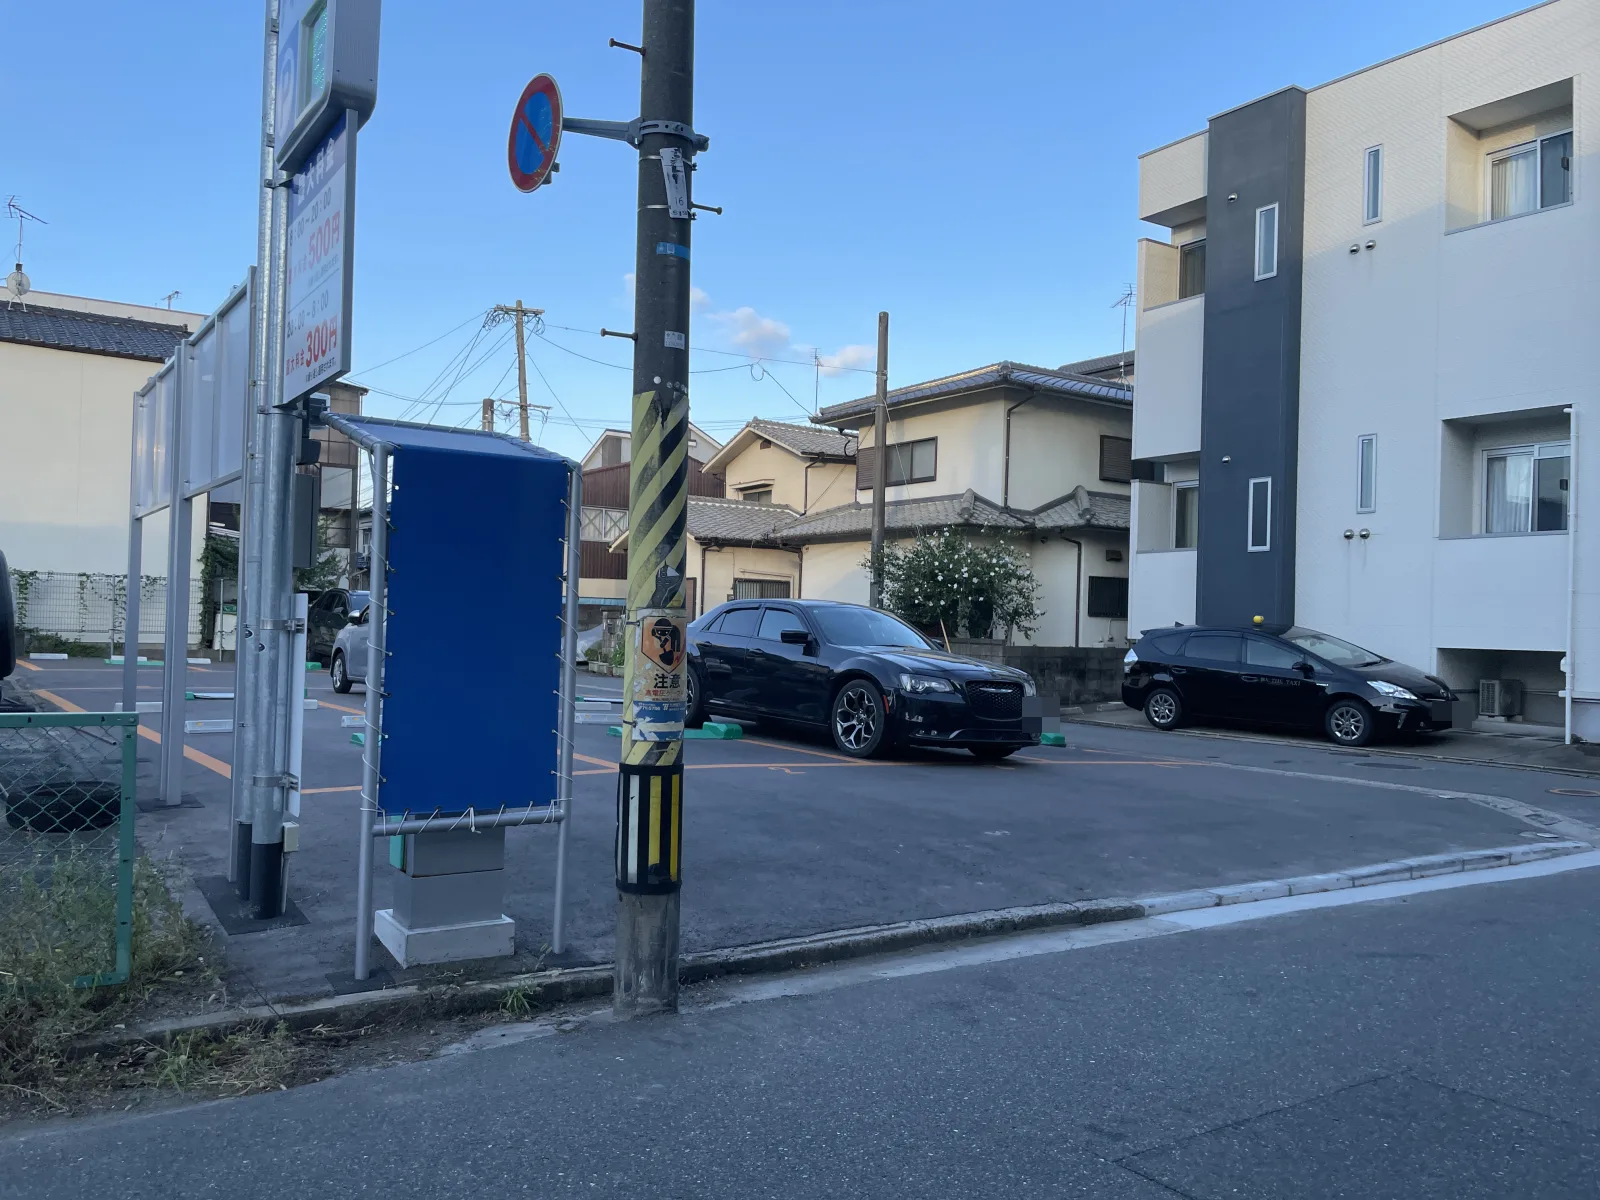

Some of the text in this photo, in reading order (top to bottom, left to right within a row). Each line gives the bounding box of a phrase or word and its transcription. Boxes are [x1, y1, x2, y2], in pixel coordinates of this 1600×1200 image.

[296, 138, 335, 206] 最大料金
[308, 209, 340, 270] 500円
[306, 314, 337, 368] 300円
[653, 673, 680, 688] 注意
